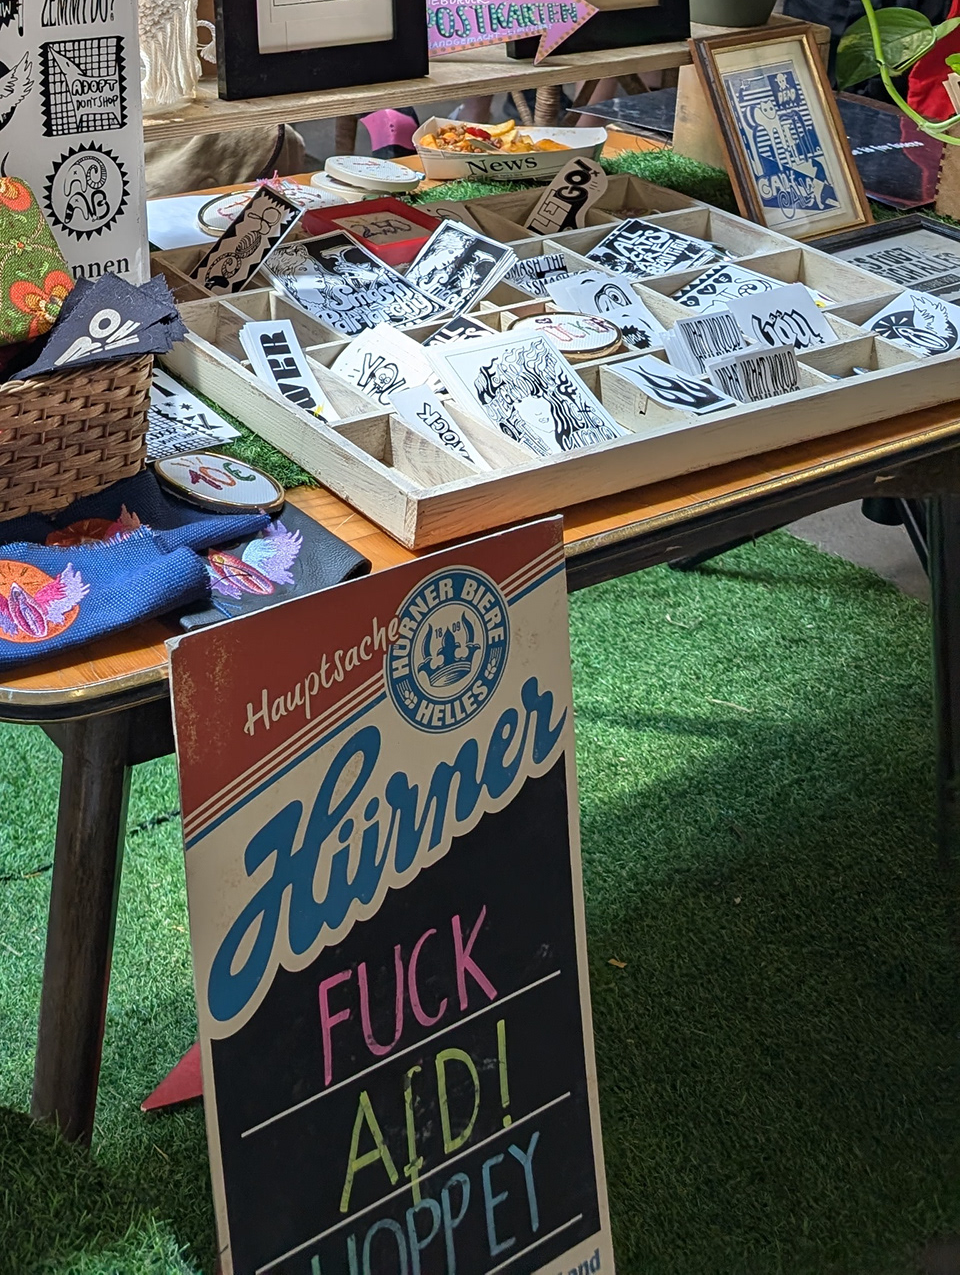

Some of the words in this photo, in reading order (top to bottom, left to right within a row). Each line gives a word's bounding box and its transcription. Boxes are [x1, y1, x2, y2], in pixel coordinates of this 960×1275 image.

[426, 2, 578, 39] POSTKARTEN
[72, 79, 117, 96] ADOPT
[98, 94, 119, 109] SHOP
[466, 156, 538, 176] News
[71, 257, 130, 279] nnen
[460, 578, 505, 645] BIERE
[434, 628, 443, 639] 18
[243, 614, 400, 736] Hauptsache
[415, 680, 488, 726] HELLES
[318, 904, 498, 1086] FUCK
